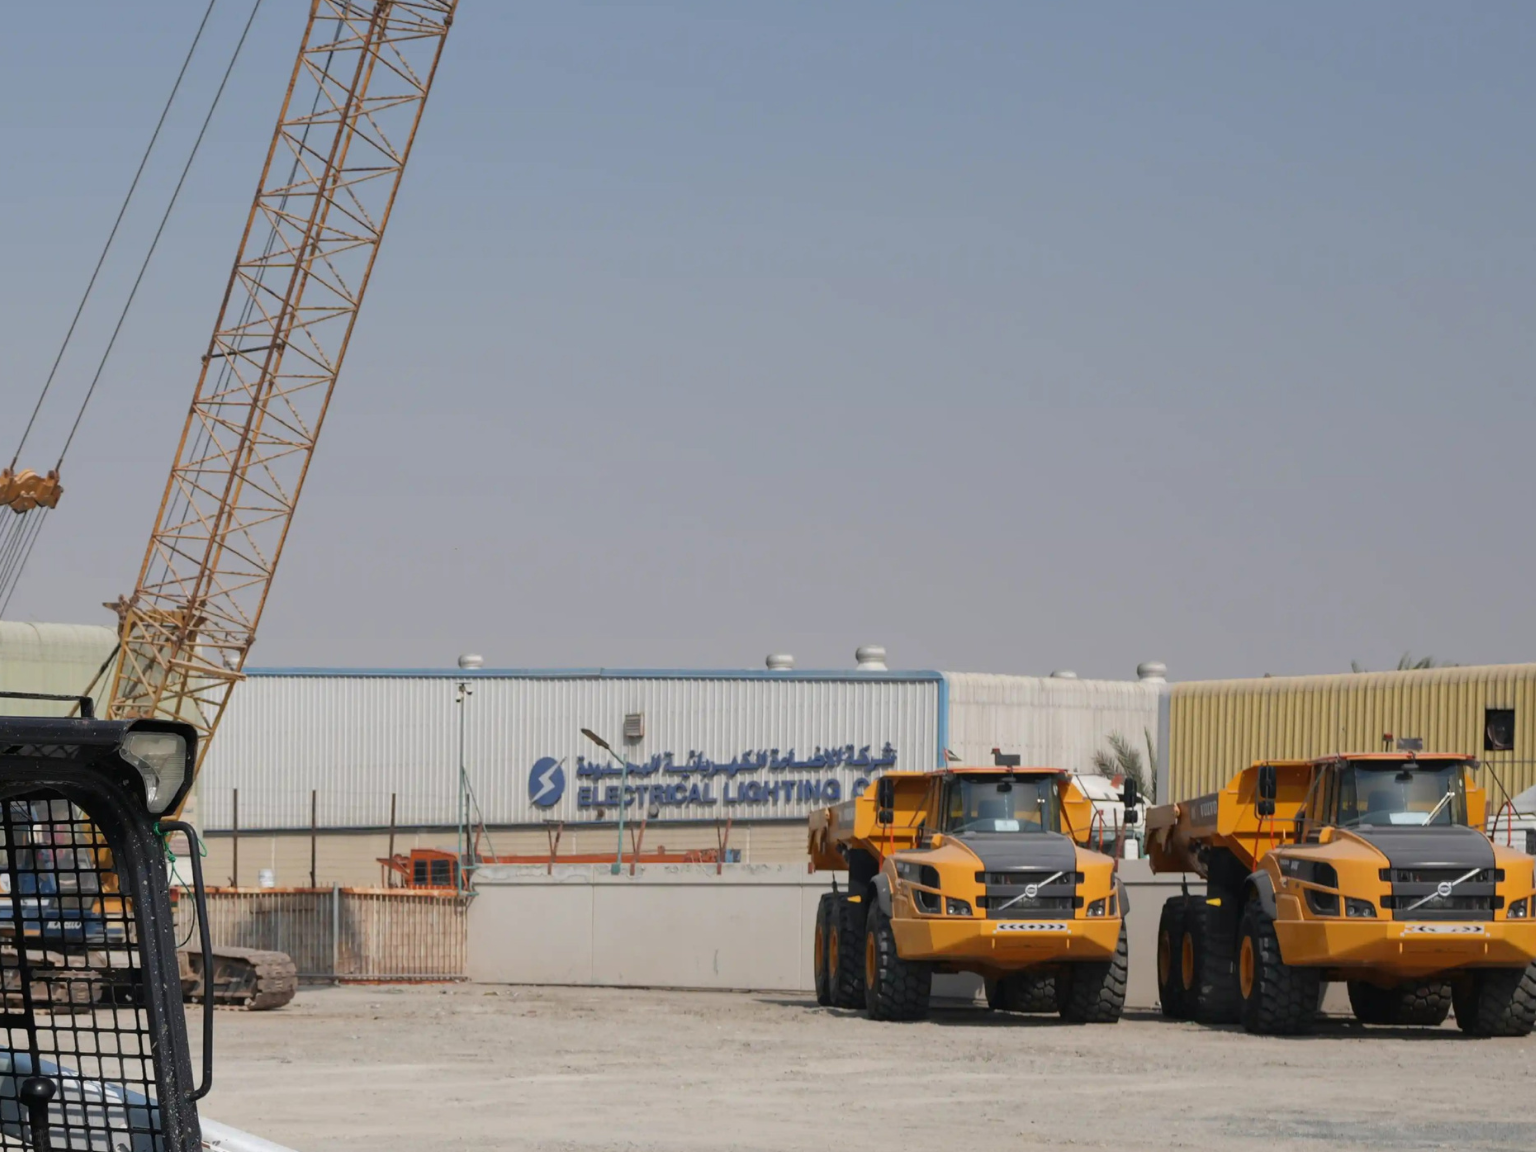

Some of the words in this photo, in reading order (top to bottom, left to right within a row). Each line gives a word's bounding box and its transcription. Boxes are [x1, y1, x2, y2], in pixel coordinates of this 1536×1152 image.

[845, 741, 897, 774] شركة
[577, 782, 717, 807] ELECTRICAL
[723, 778, 841, 804] LIGHTING
